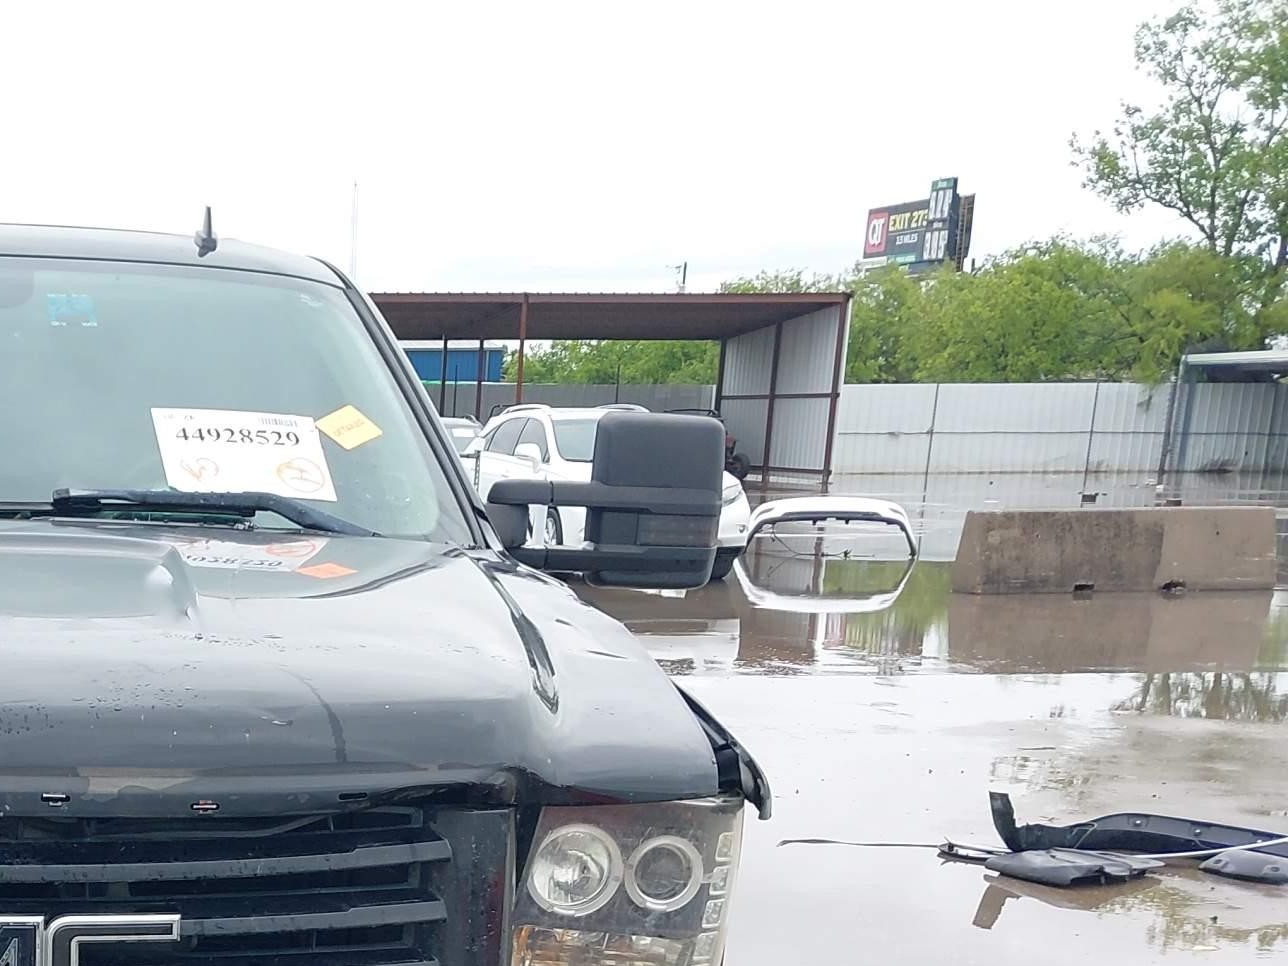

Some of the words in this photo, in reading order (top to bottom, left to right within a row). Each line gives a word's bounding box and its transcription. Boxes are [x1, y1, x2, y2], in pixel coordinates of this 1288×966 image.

[868, 217, 886, 247] QT
[888, 211, 911, 232] EXIT
[175, 426, 301, 448] 44928529
